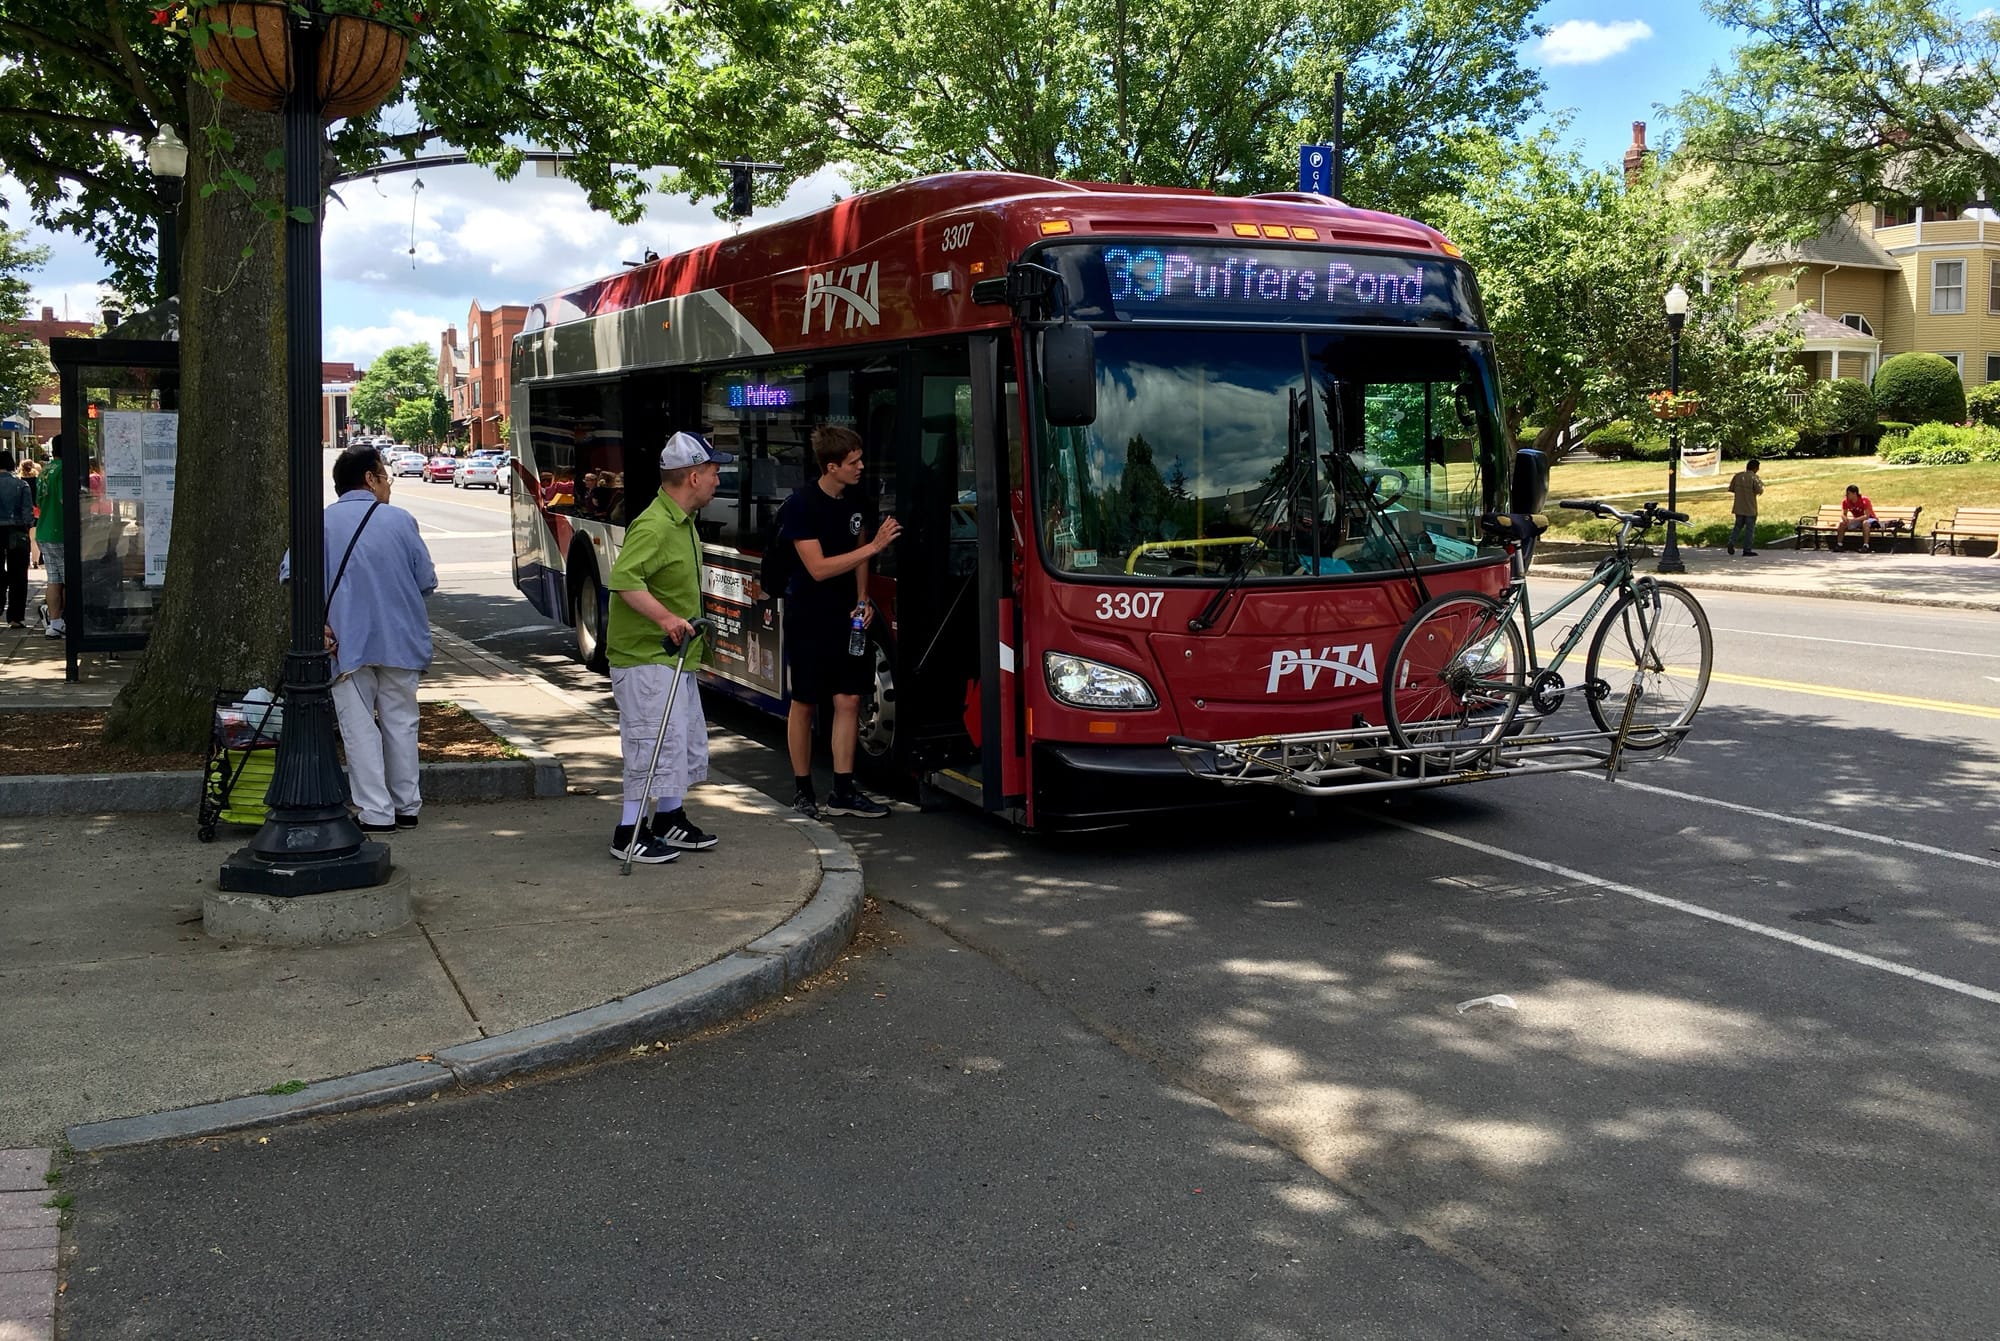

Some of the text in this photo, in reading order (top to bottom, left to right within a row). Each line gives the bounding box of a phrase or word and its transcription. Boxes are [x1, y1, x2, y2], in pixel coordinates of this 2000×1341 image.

[941, 222, 975, 252] 3307
[1104, 248, 1423, 305] 33 Puffers Pond
[801, 260, 880, 335] PVTA
[730, 384, 787, 406] 33 Puffers
[1095, 591, 1165, 620] 3307
[1262, 643, 1379, 694] PVTA
